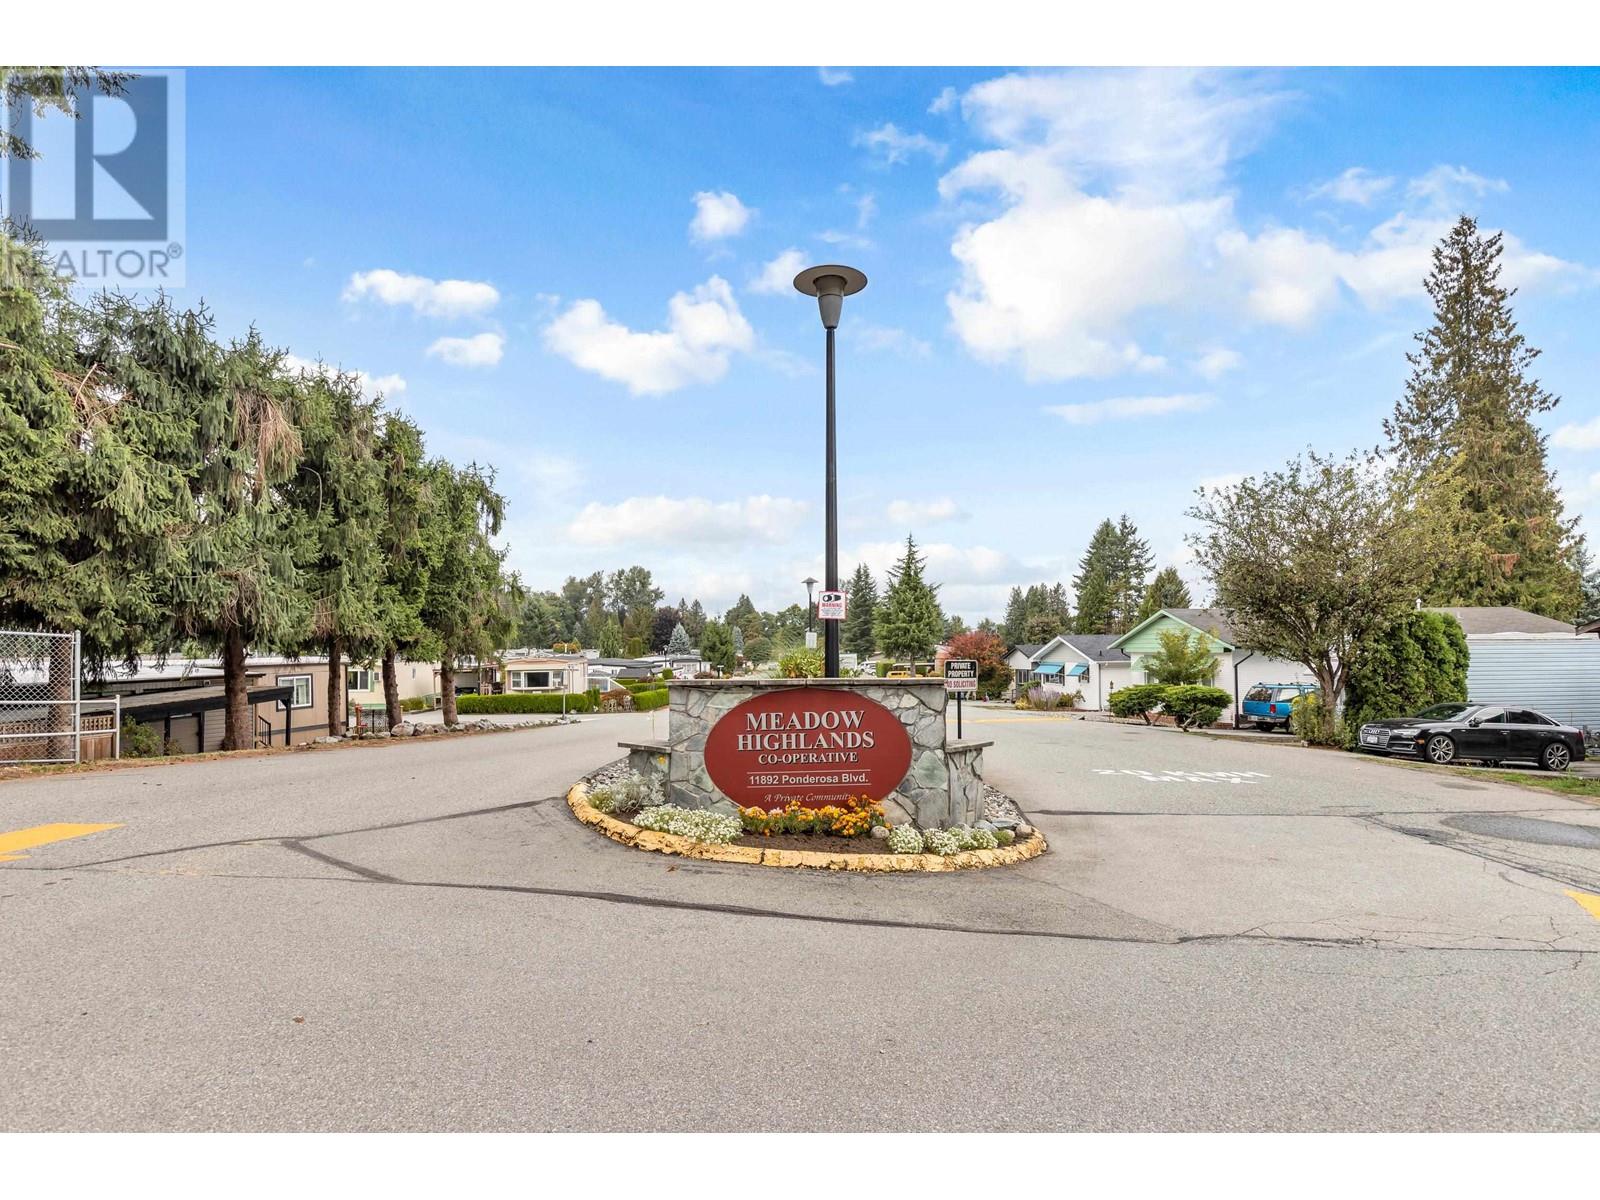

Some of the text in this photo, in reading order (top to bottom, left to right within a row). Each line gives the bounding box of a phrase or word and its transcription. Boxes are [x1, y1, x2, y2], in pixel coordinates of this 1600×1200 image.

[950, 662, 972, 670] PRIVATE
[947, 670, 975, 678] PROPERTY
[953, 680, 976, 688] SOLICITING
[746, 710, 865, 732] MEADOW
[737, 731, 876, 751] HIGHLANDS
[758, 752, 859, 765] CO-OPERATIVE
[749, 773, 869, 785] 11892 Ponderosa Blvd.
[764, 792, 852, 802] A Private Communit
